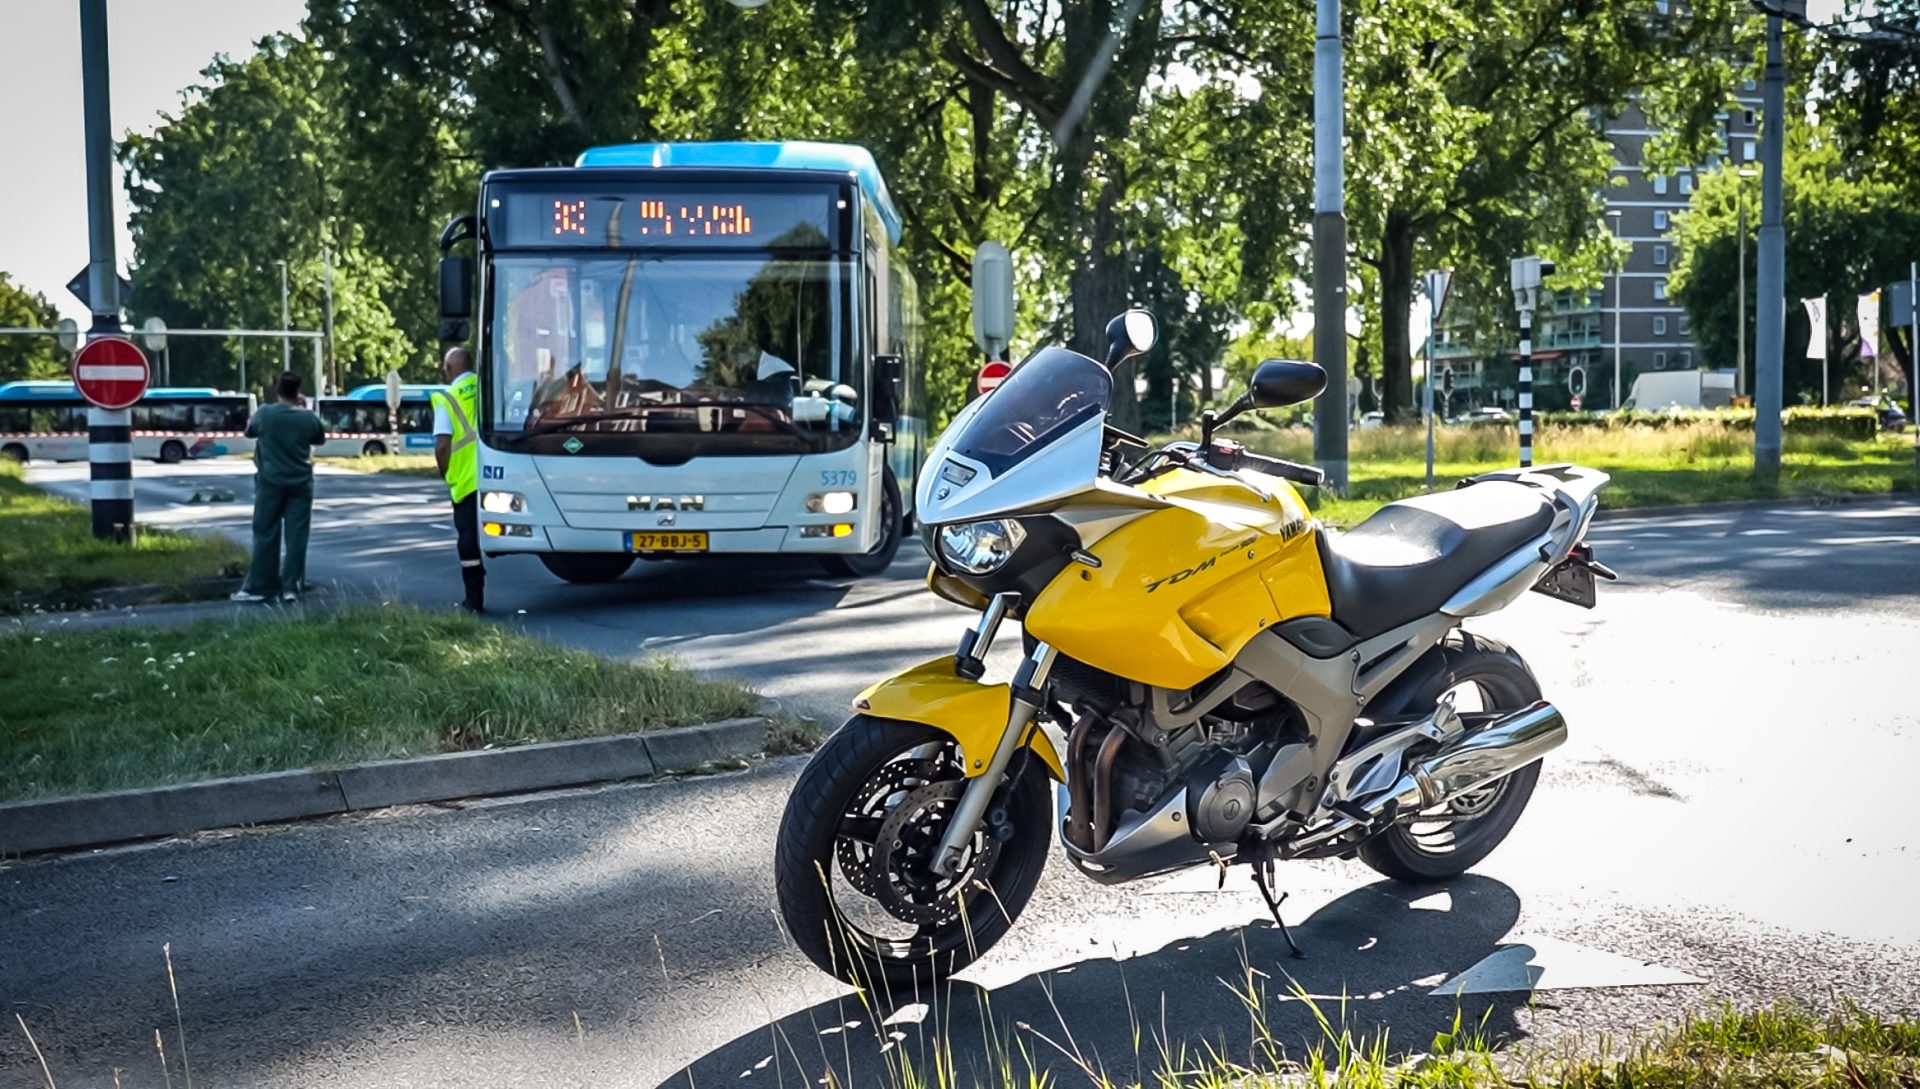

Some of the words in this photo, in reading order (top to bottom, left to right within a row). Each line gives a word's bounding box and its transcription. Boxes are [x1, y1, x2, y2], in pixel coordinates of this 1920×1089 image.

[821, 470, 857, 486] 5379
[626, 495, 704, 511] MAN
[639, 535, 702, 548] 27-BBJ-5
[1145, 556, 1217, 593] TDM
